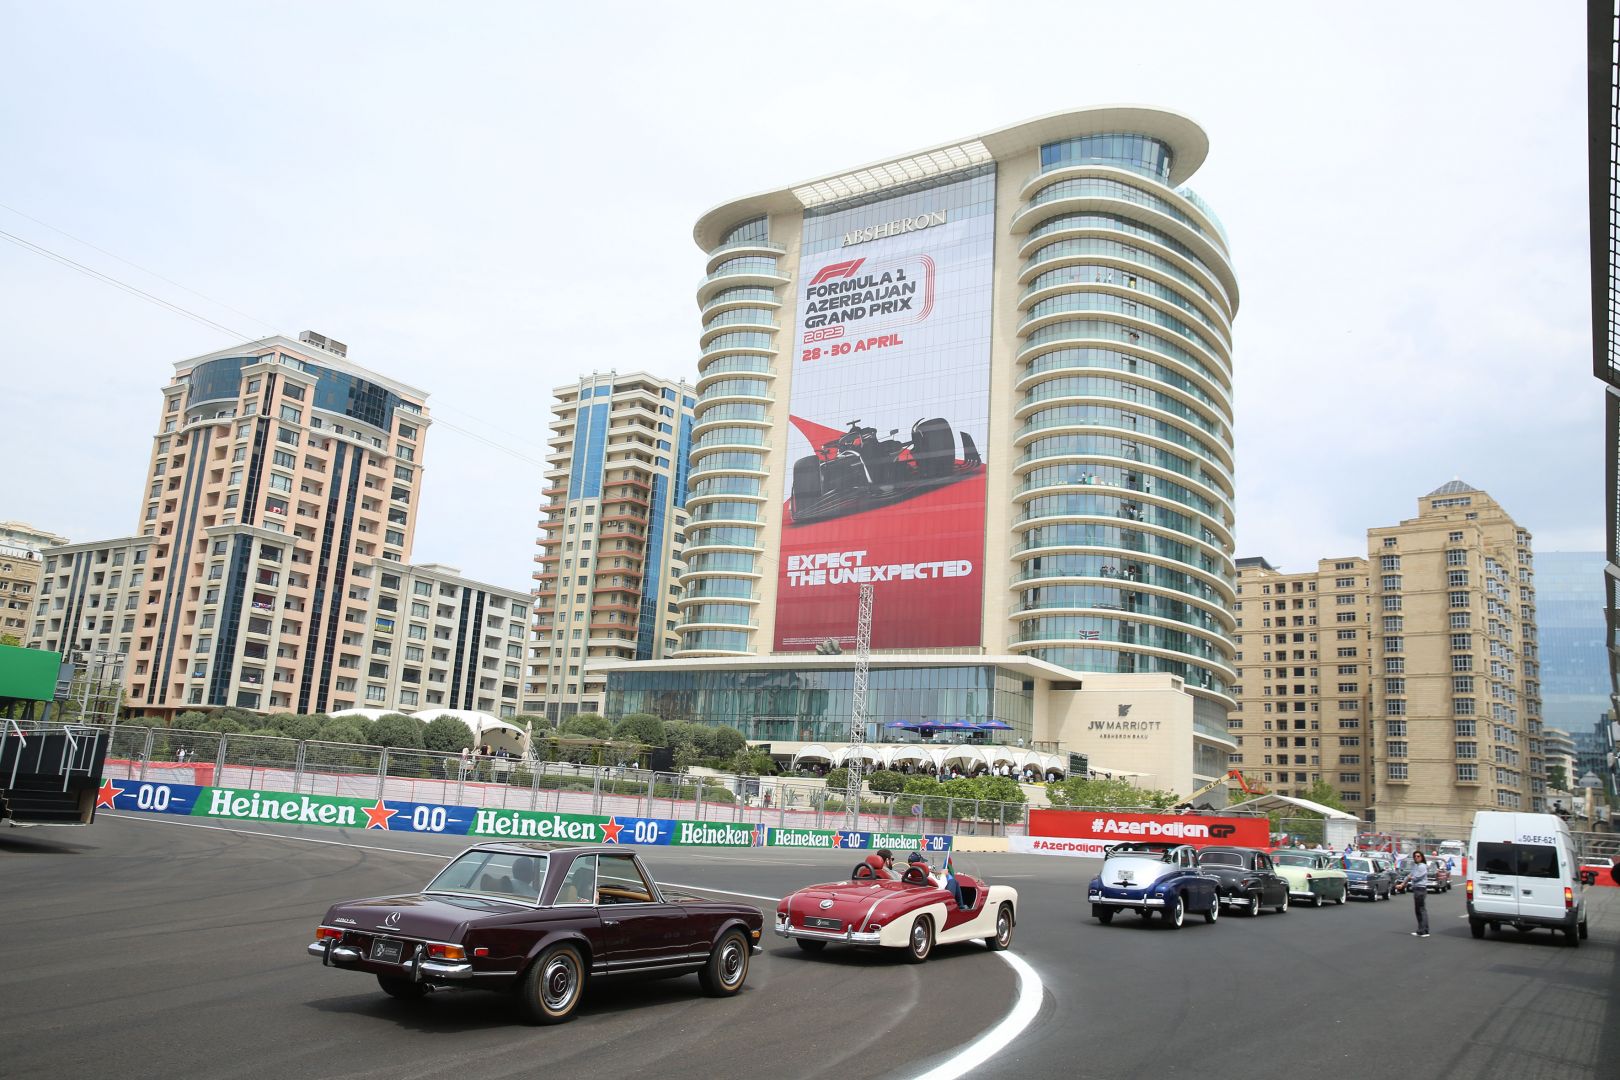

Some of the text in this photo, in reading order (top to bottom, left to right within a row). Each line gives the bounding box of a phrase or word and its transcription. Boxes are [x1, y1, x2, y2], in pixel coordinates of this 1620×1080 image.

[842, 209, 947, 248] ABSHERON
[806, 269, 906, 300] FORMULA 1
[805, 281, 916, 315] AZERBAIJAN
[804, 296, 912, 329] GRAND PRIX
[803, 325, 845, 344] 2023
[802, 347, 821, 361] 28
[831, 342, 851, 356] 30
[854, 333, 903, 352] APRIL
[787, 550, 867, 571] EXPECT
[787, 559, 973, 587] THE UNEXPECTED
[1088, 721, 1161, 730] JW MARRIOTT
[136, 784, 171, 811] 0.0
[208, 789, 356, 825] Heineken
[412, 805, 447, 832] 0.0
[474, 808, 596, 840] Heineken
[1091, 818, 1236, 838] #AzerbaijanGP
[634, 821, 658, 843] 0.0
[680, 823, 749, 845] Heineken
[774, 829, 829, 847] Heineken
[872, 834, 917, 849] Heineken
[1523, 835, 1556, 844] 50-EF-621
[1033, 840, 1118, 853] #AzerbaijanG
